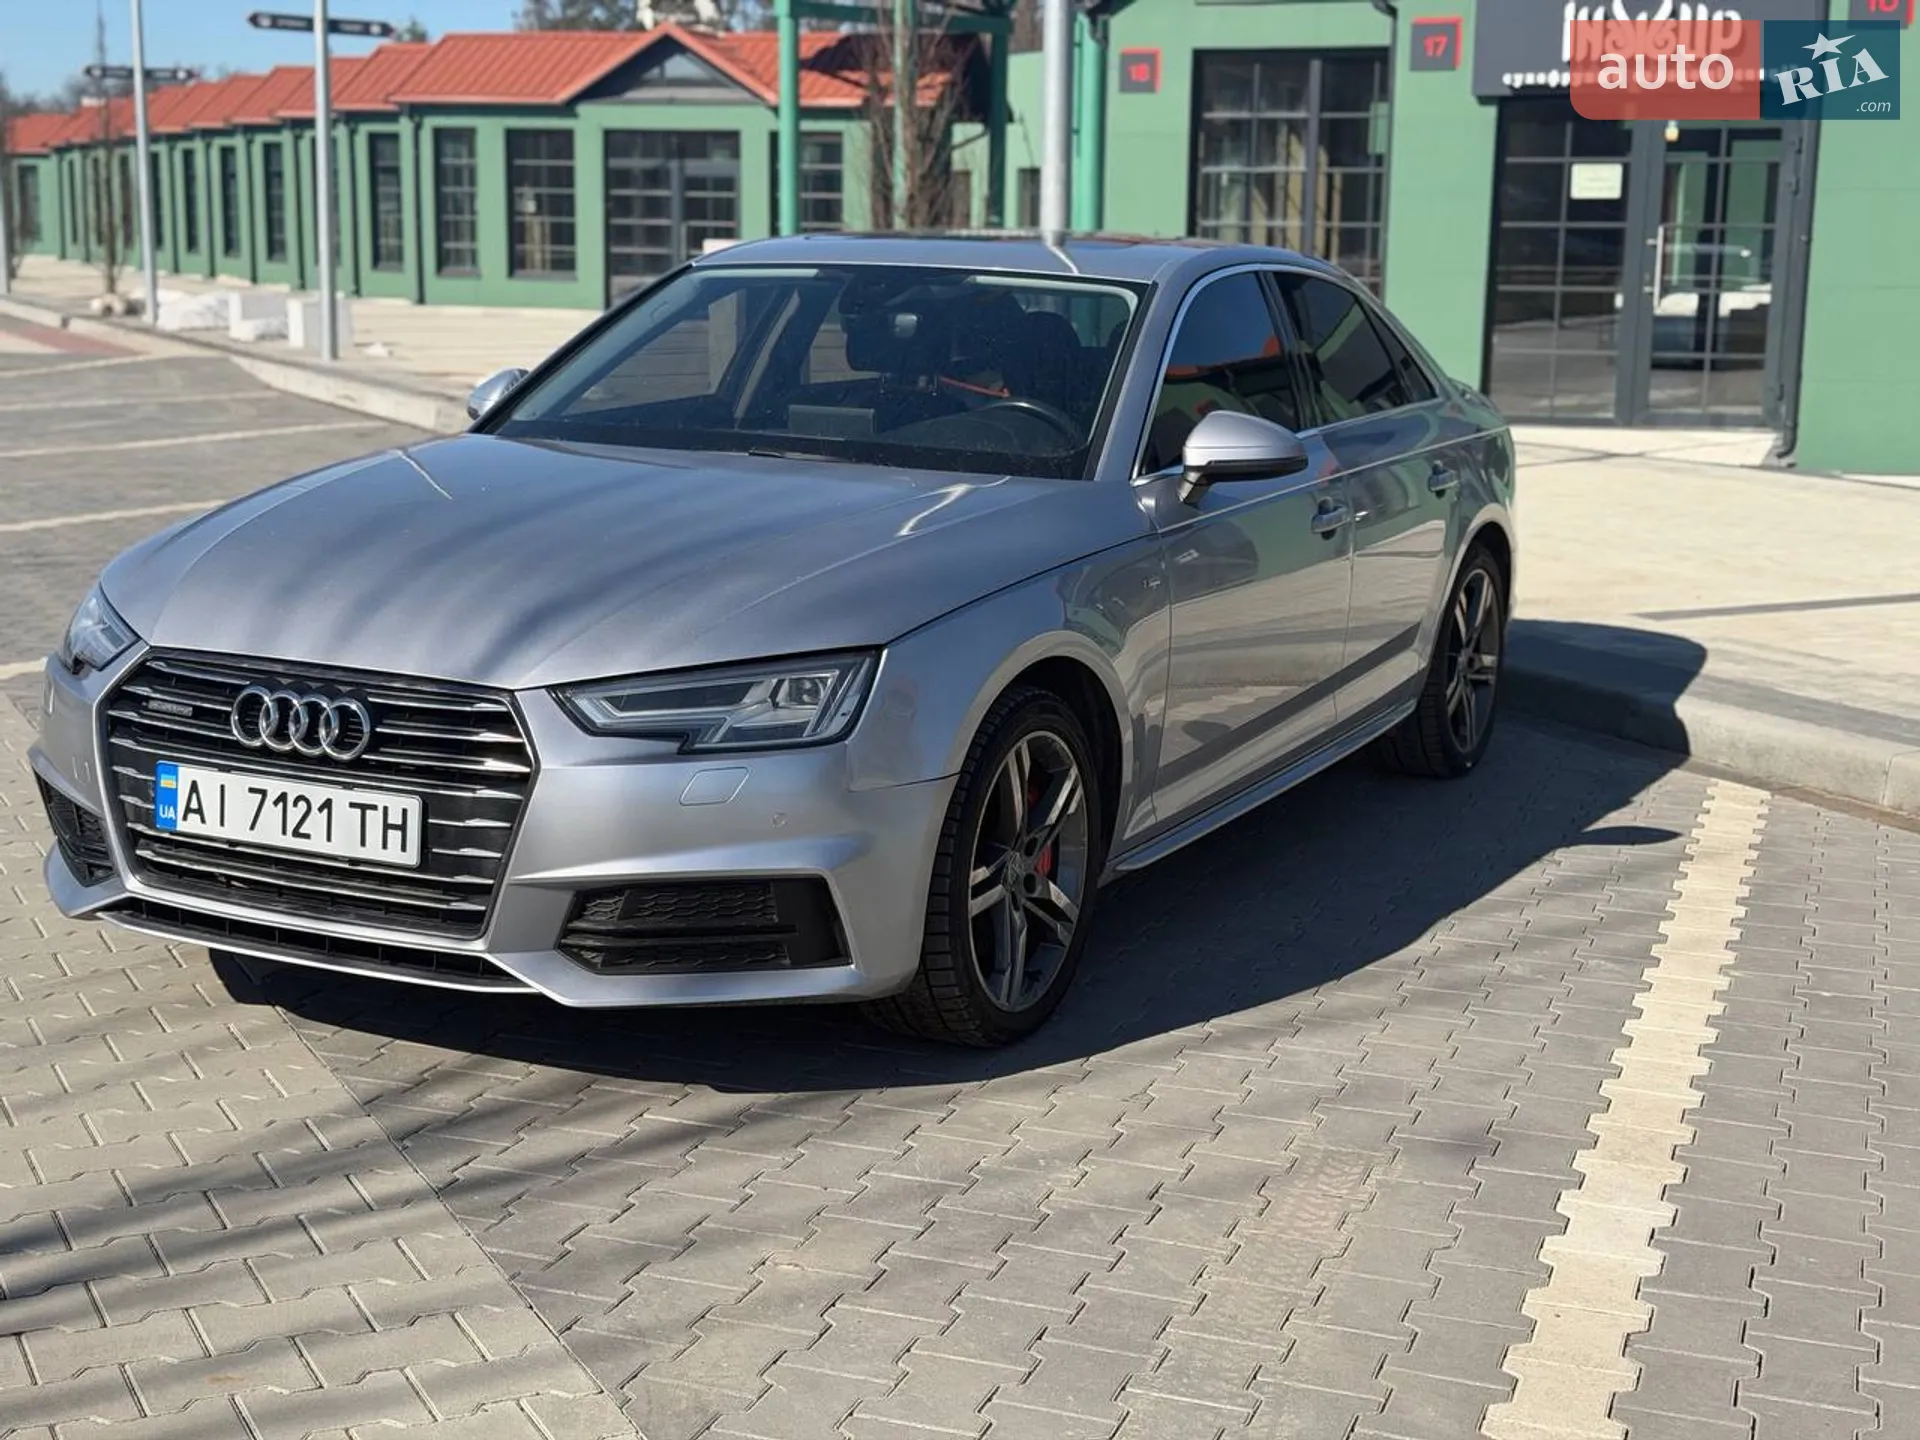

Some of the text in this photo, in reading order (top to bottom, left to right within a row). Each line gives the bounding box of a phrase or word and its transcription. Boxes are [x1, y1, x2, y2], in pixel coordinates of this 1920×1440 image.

[1424, 35, 1448, 58] 17
[160, 806, 176, 821] UA
[182, 779, 408, 853] AI 7121 TH
